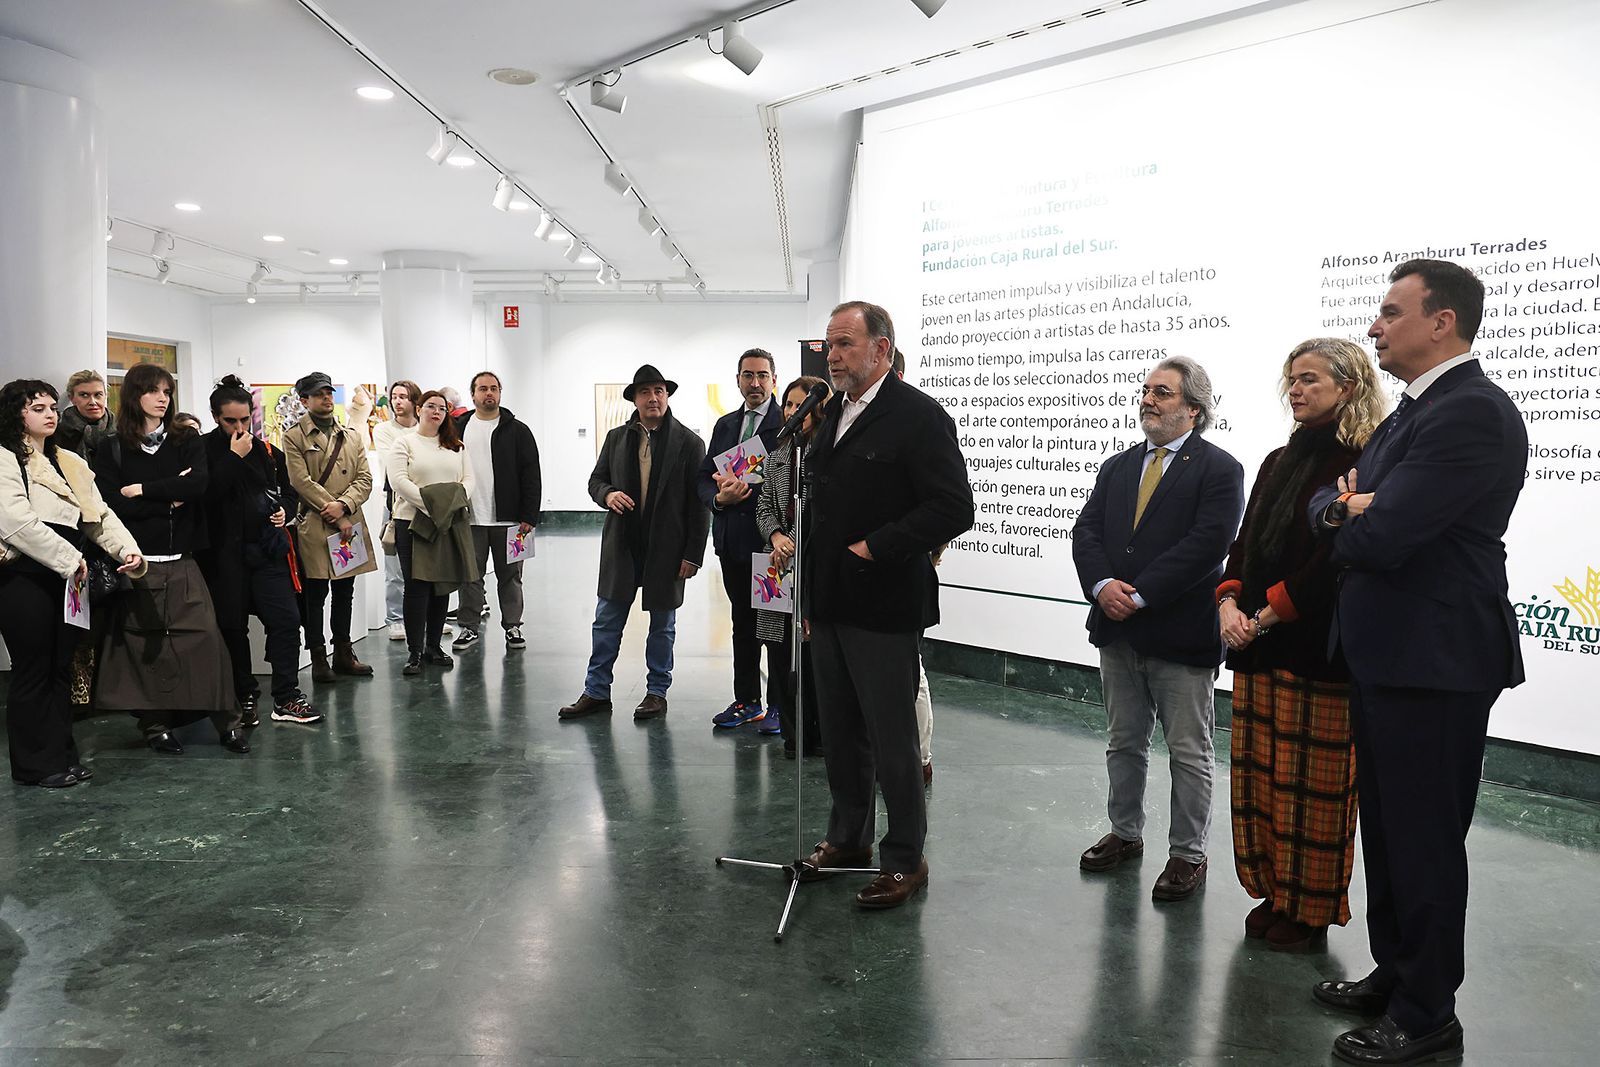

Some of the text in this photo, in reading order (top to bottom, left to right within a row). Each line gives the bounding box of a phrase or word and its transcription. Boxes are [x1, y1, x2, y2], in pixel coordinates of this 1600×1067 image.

[922, 241, 949, 256] para
[1006, 225, 1064, 241] artistas.
[922, 238, 1118, 272] Fundación Caja Rural del Sur.
[1322, 238, 1547, 269] Alfonso Aramburu Terrades
[1321, 273, 1387, 289] Arquitect
[1477, 260, 1520, 276] acido
[1526, 261, 1546, 272] en
[922, 267, 1216, 306] Este certamen impulsa y visibiliza el talento
[1321, 296, 1345, 308] Fue
[1514, 284, 1522, 297] y
[1528, 274, 1599, 293] desarrol
[921, 293, 1192, 329] joven en las artes plásticas en Andalucía,
[1484, 307, 1498, 317] ra
[1505, 304, 1517, 316] la
[1523, 300, 1587, 315] ciudad.
[922, 314, 1230, 347] dando proyección a artistas de hasta 35 años.
[1476, 325, 1525, 339] dades
[920, 348, 1167, 368] Al mismo tiempo, impulsa las carreras
[1486, 345, 1548, 359] alcalde,
[1554, 343, 1600, 357] adem
[919, 374, 971, 388] artísticas
[974, 373, 990, 386] de
[993, 372, 1010, 386] los
[1014, 370, 1109, 386] seleccionados
[1508, 369, 1527, 379] en
[1534, 365, 1600, 378] instituc
[961, 396, 968, 406] a
[971, 394, 1024, 410] espacios
[1028, 393, 1105, 410] expositivos
[1109, 392, 1127, 407] de
[1508, 386, 1589, 403] ayectoria
[959, 413, 1136, 432] el arte contemporáneo a la
[979, 437, 994, 448] en
[998, 435, 1029, 449] valor
[1033, 436, 1044, 450] la
[1047, 436, 1097, 455] pintura
[1101, 439, 1109, 454] y
[1113, 434, 1125, 452] la
[965, 456, 1012, 472] nguajes
[1016, 457, 1080, 472] culturales
[1535, 467, 1575, 480] sirve
[1001, 485, 1045, 497] genera
[1050, 486, 1067, 497] un
[981, 503, 1012, 515] entre
[992, 542, 1043, 558] cultural.
[1520, 620, 1561, 639] AJA
[1544, 640, 1600, 655] DEL SU
